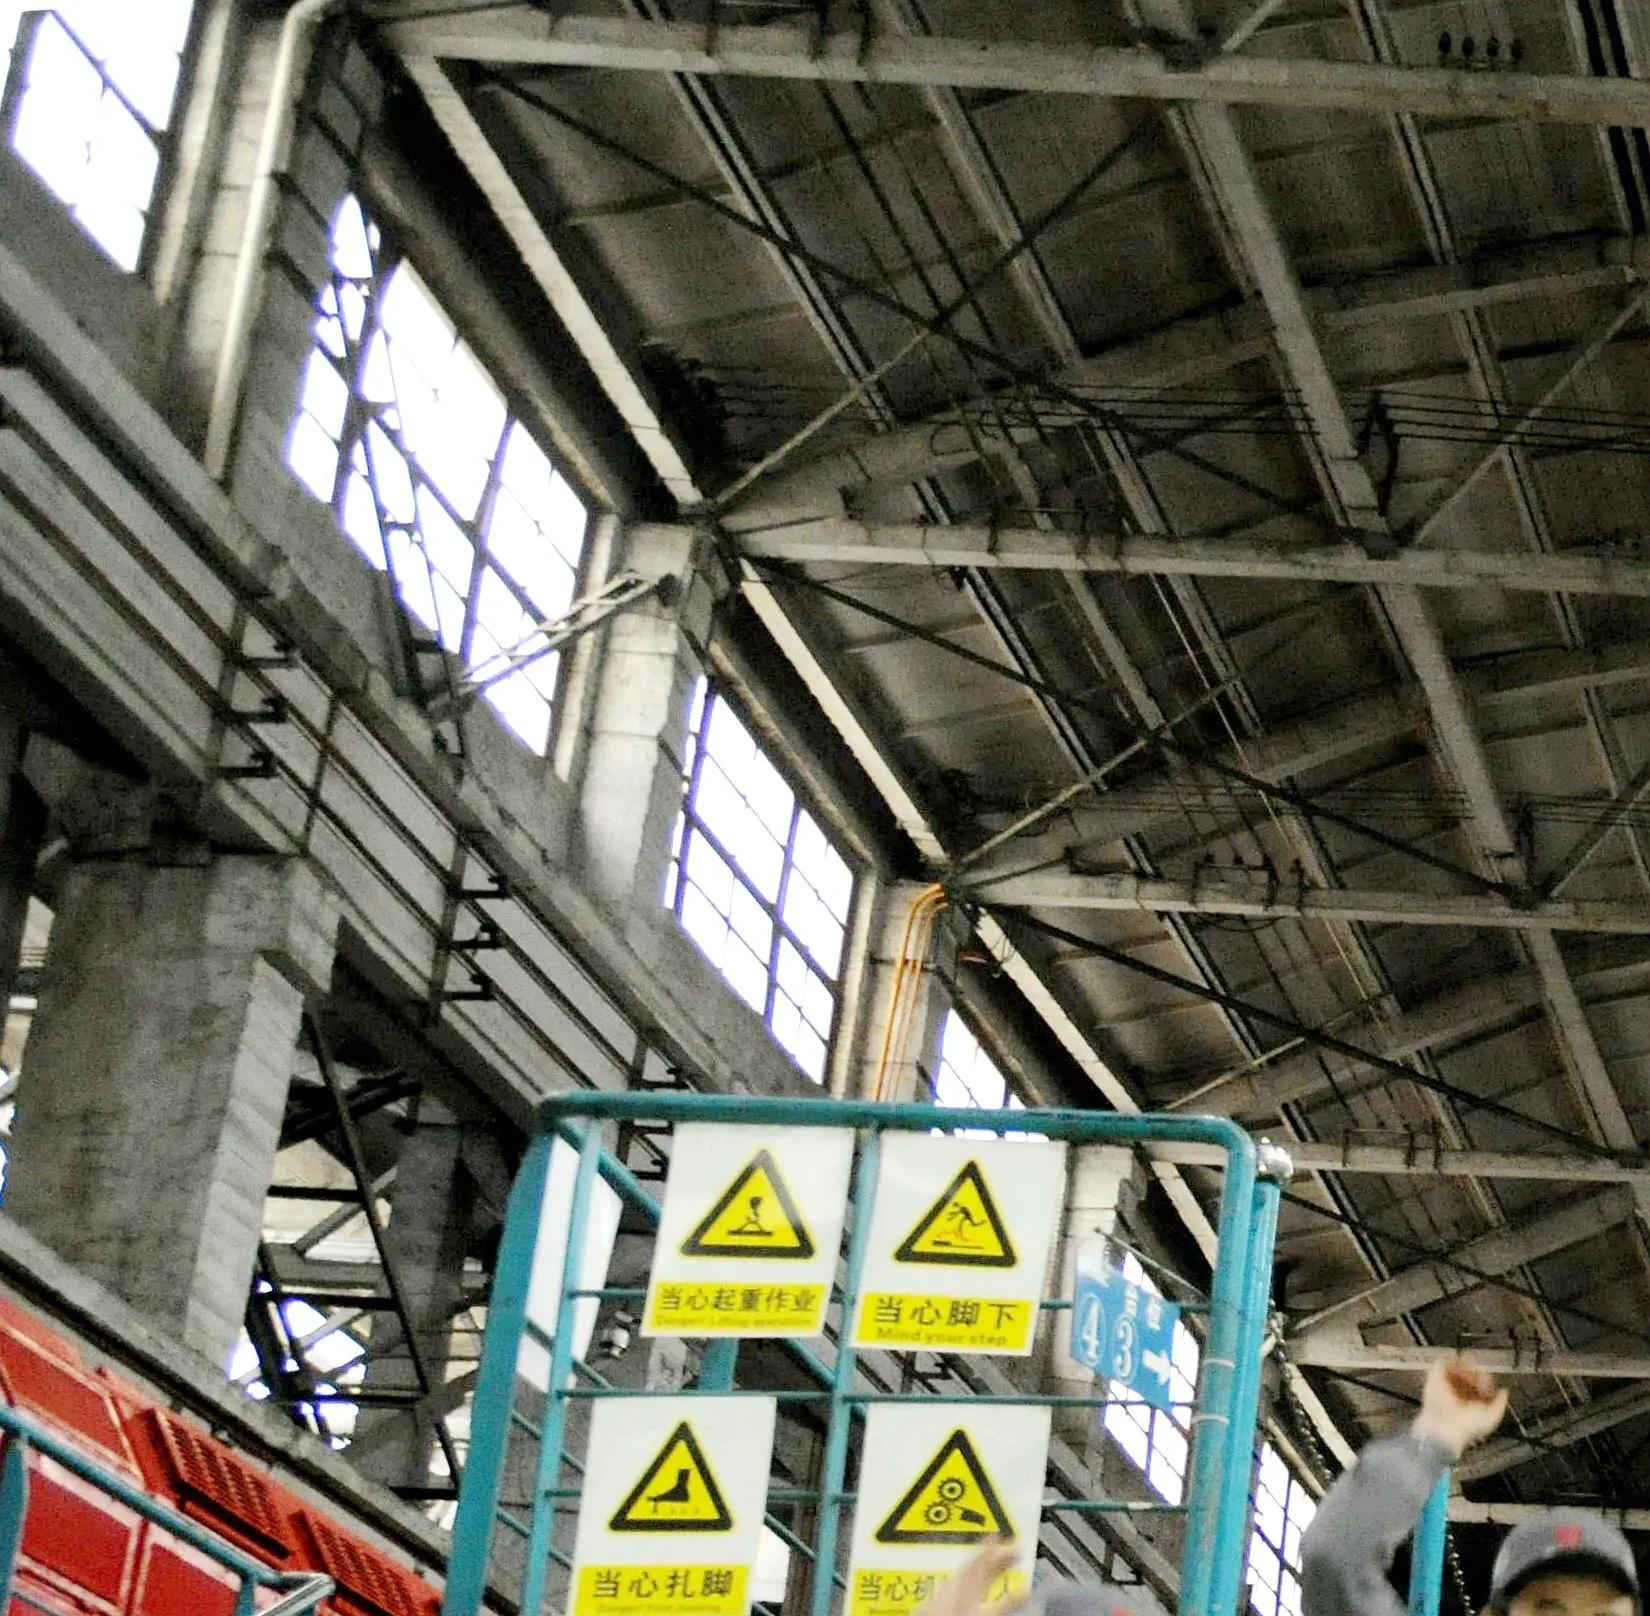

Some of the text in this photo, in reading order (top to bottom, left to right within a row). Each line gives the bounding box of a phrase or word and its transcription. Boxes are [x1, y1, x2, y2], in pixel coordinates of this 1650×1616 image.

[660, 1286, 815, 1311] 当心起重作业
[875, 1296, 1018, 1328] 当心脚下
[970, 1333, 1008, 1347] step
[594, 1569, 733, 1598] 当心扎脚
